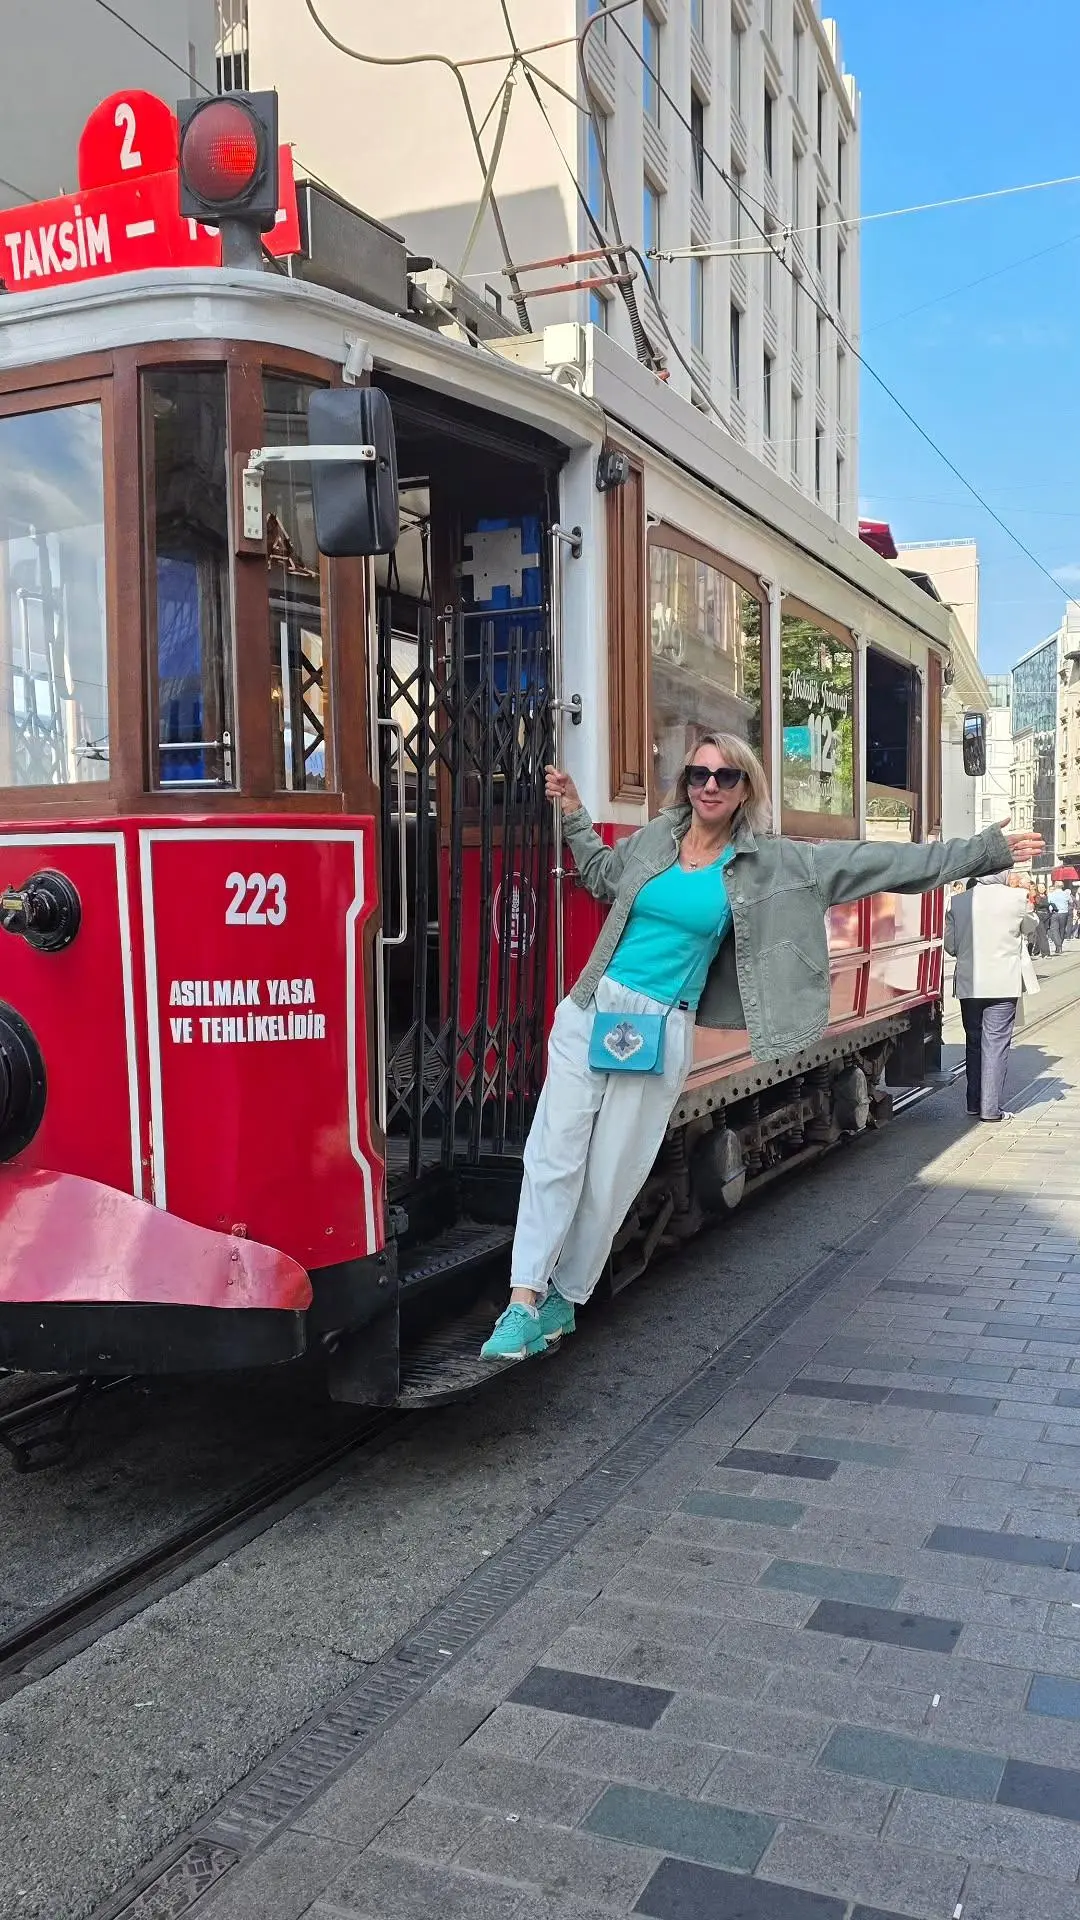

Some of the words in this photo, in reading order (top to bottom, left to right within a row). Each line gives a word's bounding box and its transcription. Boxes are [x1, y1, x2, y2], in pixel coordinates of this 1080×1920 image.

[115, 102, 142, 170] 2
[5, 205, 112, 280] TAKSİM
[808, 712, 833, 773] 112
[225, 872, 287, 926] 223
[169, 980, 260, 1006] ASILMAK
[266, 978, 316, 1005] YASA
[169, 1018, 193, 1043] VE
[199, 1010, 326, 1043] TEHLİKELİDİR
